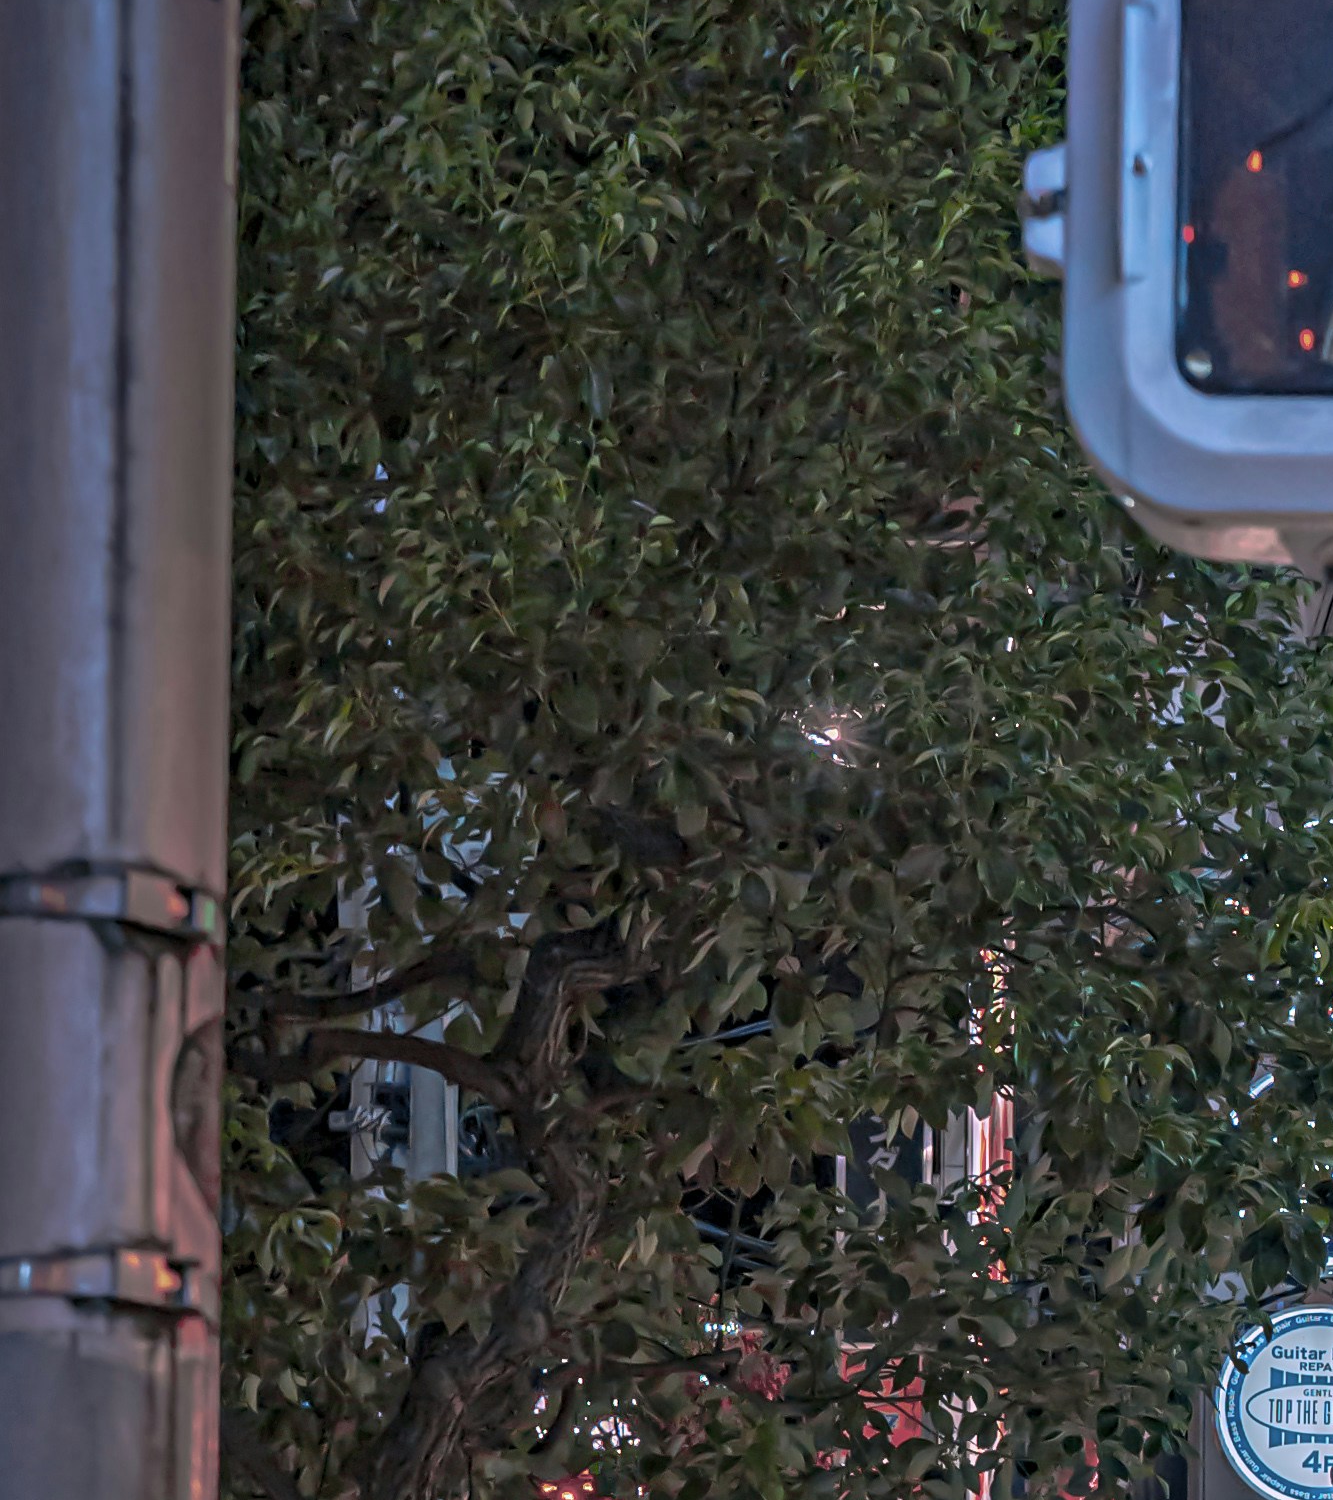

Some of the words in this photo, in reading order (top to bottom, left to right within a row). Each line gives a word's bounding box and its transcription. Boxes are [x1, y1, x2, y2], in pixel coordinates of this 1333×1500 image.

[1271, 1345, 1326, 1361] Guitar
[1268, 1398, 1293, 1424] TOP
[1296, 1399, 1319, 1425] THE
